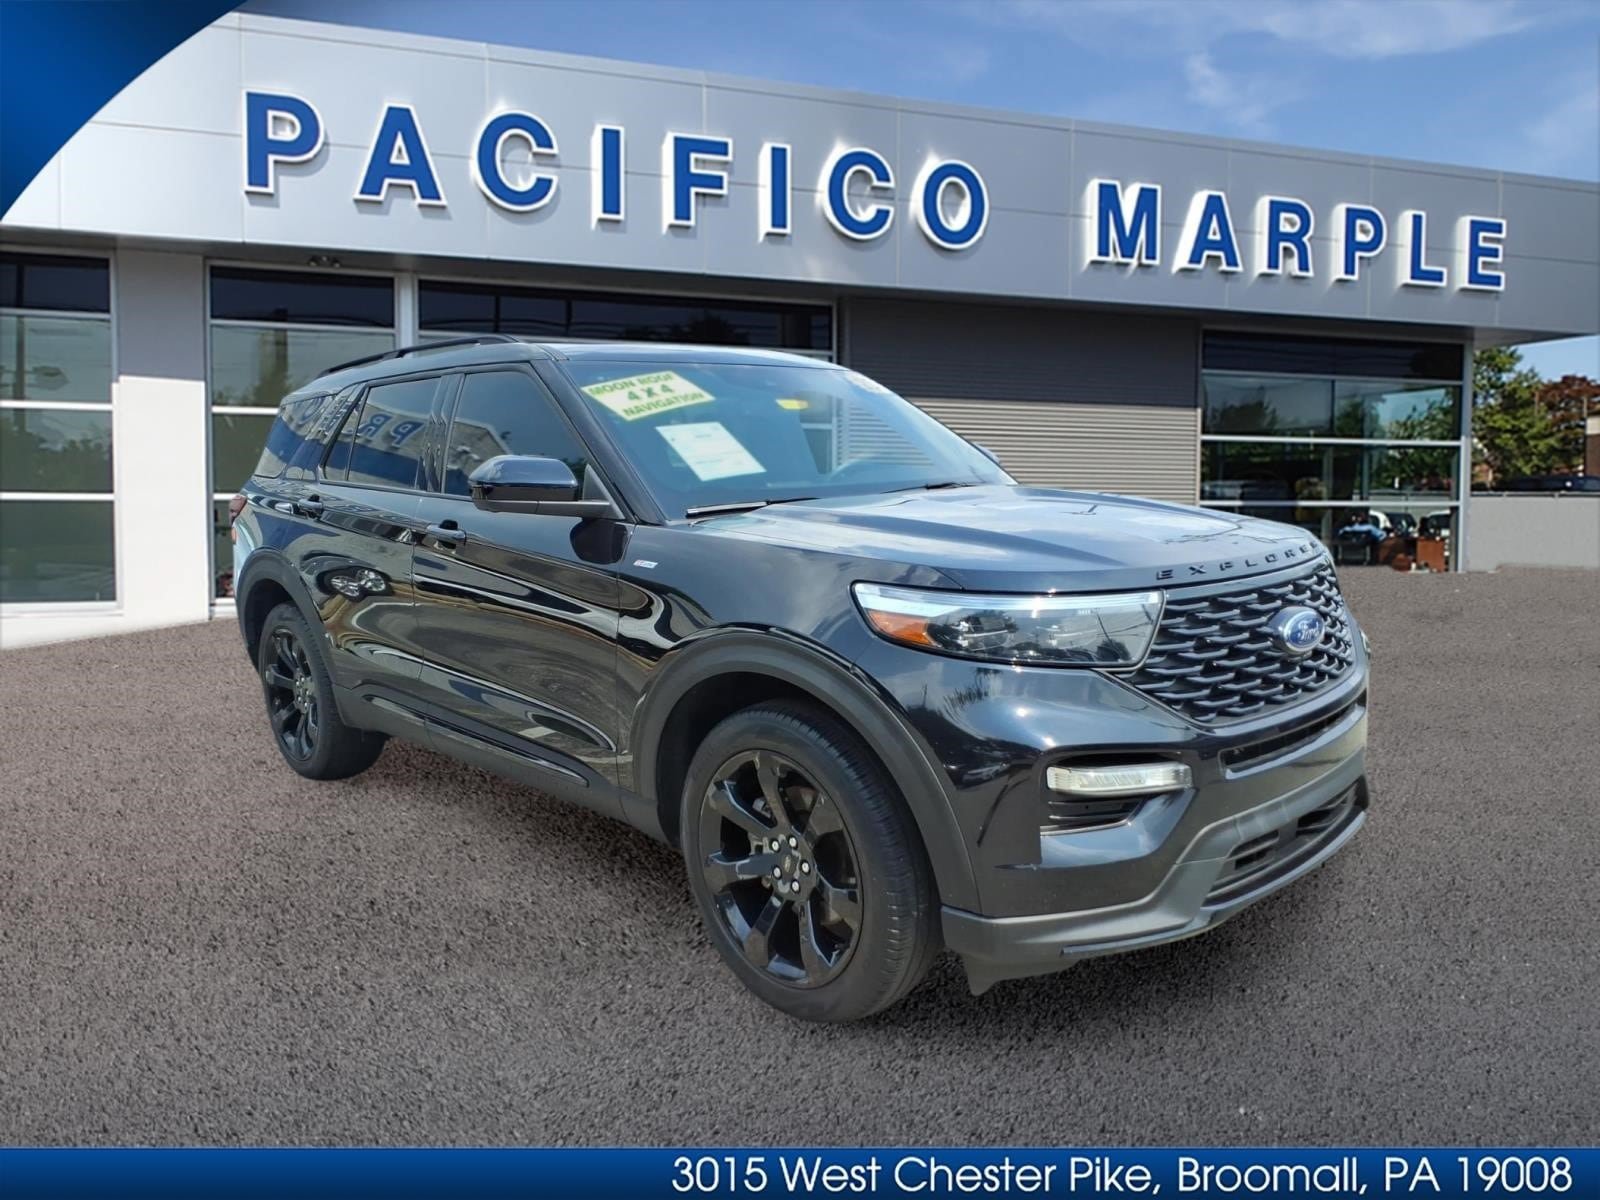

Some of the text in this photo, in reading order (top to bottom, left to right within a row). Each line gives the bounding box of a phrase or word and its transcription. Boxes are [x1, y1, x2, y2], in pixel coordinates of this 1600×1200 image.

[243, 88, 1507, 292] PACIFICO MARPLE
[589, 379, 635, 396] MOON
[622, 392, 705, 417] NAVIGATION
